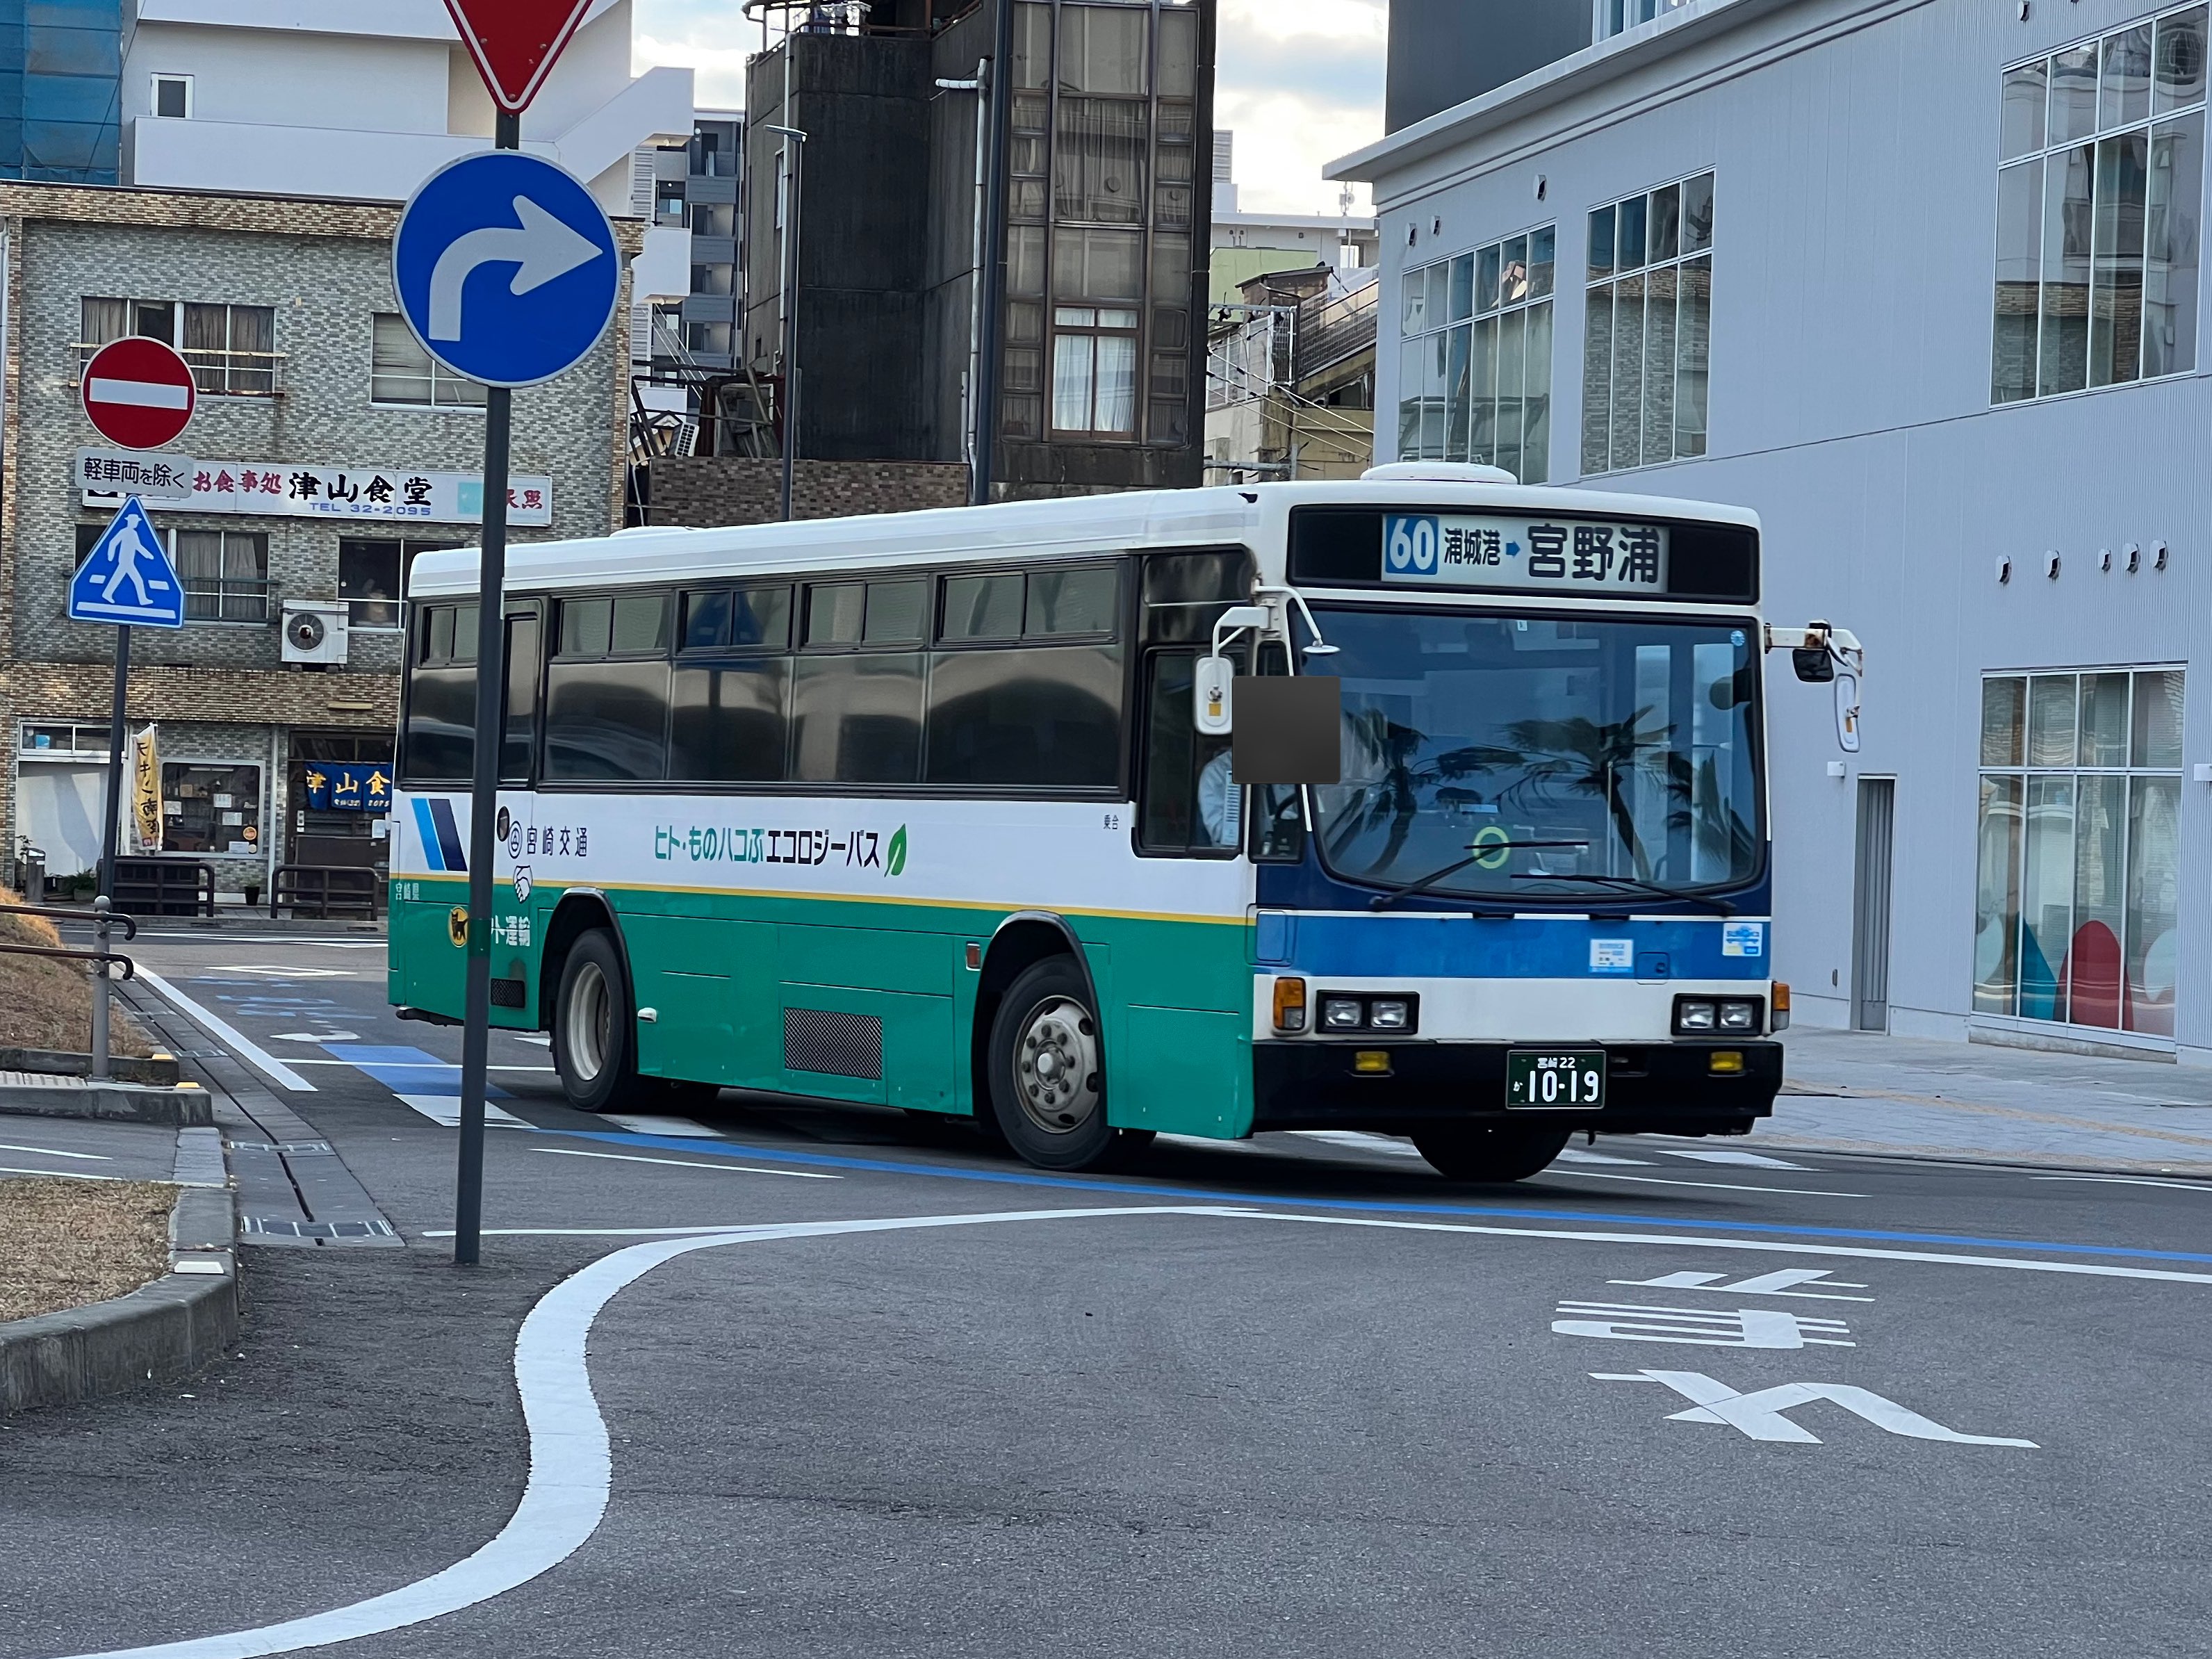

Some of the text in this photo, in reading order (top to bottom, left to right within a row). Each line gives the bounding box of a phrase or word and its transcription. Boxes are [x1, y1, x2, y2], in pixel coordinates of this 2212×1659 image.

[84, 457, 184, 488] 軽車両を除く
[193, 469, 281, 494] お食事処
[289, 472, 432, 506] 津山食堂
[310, 502, 431, 516] TEL 32-2095
[1390, 518, 1434, 570] 60
[1444, 523, 1660, 583] 浦城港 宮野浦
[527, 826, 587, 857] 宮崎交通
[491, 915, 530, 946] ト運輸
